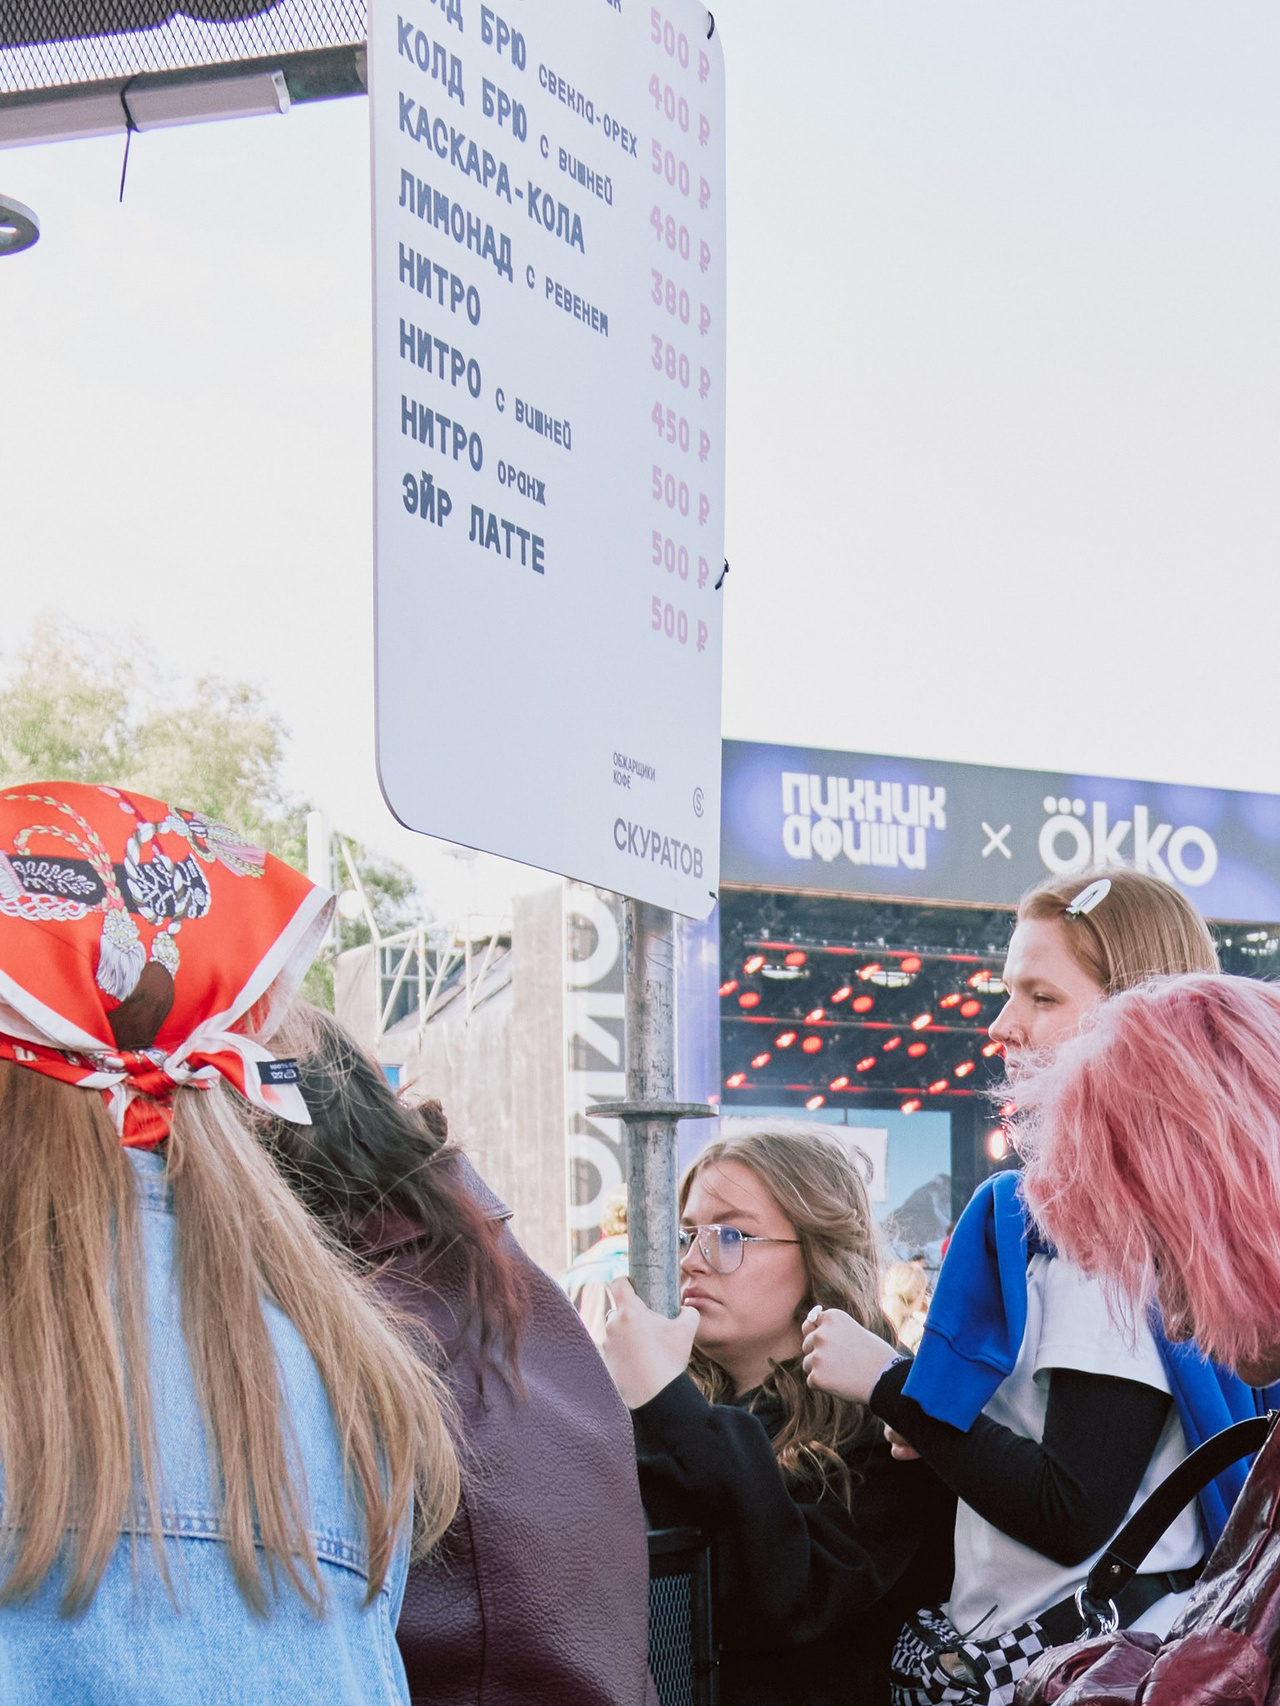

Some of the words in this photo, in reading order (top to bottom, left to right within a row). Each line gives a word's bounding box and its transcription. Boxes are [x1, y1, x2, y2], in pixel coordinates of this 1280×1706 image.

[480, 3, 526, 72] БРЮ
[651, 7, 689, 69] 500
[397, 14, 465, 107] КОЛД
[482, 76, 527, 143] БРЮ
[649, 74, 689, 133] 400
[399, 90, 585, 255] КАСКАРА-КОЛА
[652, 139, 689, 196] 500
[398, 168, 513, 284] ЛИМОНАД
[545, 276, 608, 338] РЕВЕНЕМ
[650, 205, 690, 261] 480
[399, 241, 481, 326] НИТРО
[651, 268, 690, 324] 380
[399, 317, 481, 399] НИТРО
[651, 334, 689, 388] 380
[401, 394, 483, 472] НИТРО
[652, 402, 689, 453] 450
[653, 465, 689, 516] 500
[402, 470, 453, 528] ЭЙР
[469, 504, 545, 575] ЛАТТЕ
[652, 530, 688, 580] 500
[652, 596, 688, 645] 500
[613, 752, 655, 782] ОБЖАРЩИКИ
[613, 770, 631, 790] КОФЕ
[613, 817, 704, 879] СКУРАТОВ
